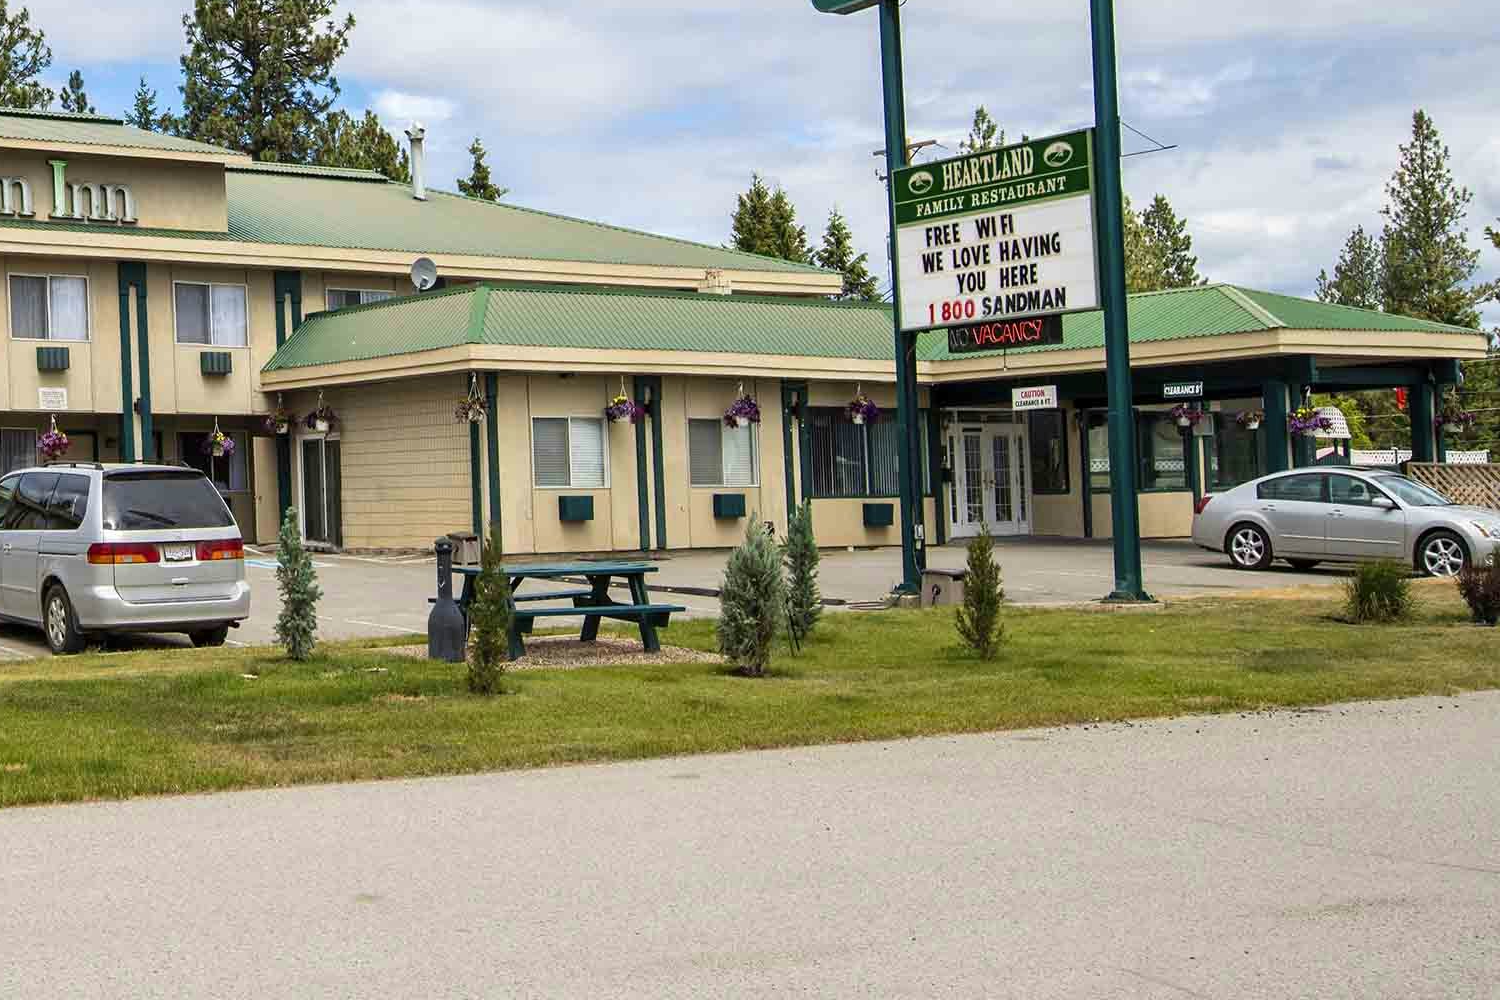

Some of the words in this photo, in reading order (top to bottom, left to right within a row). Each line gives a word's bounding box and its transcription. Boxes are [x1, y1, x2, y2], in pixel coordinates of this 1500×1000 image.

[942, 145, 1034, 191] HEARTLAND
[45, 159, 139, 224] Inn
[916, 196, 965, 217] FAMILY
[971, 176, 1067, 207] RESTAURANT
[925, 223, 961, 248] FREE
[922, 250, 944, 274] WE
[953, 244, 990, 269] LOVE
[1000, 231, 1061, 263] HAVING
[956, 271, 987, 294] YOU
[1000, 263, 1038, 289] HERE
[982, 286, 1067, 316] SANDMAN
[972, 319, 1043, 345] VACANCY
[1015, 399, 1040, 408] CLEARANCE
[1020, 389, 1045, 399] CAUTION
[1164, 385, 1196, 395] CLEARANCE
